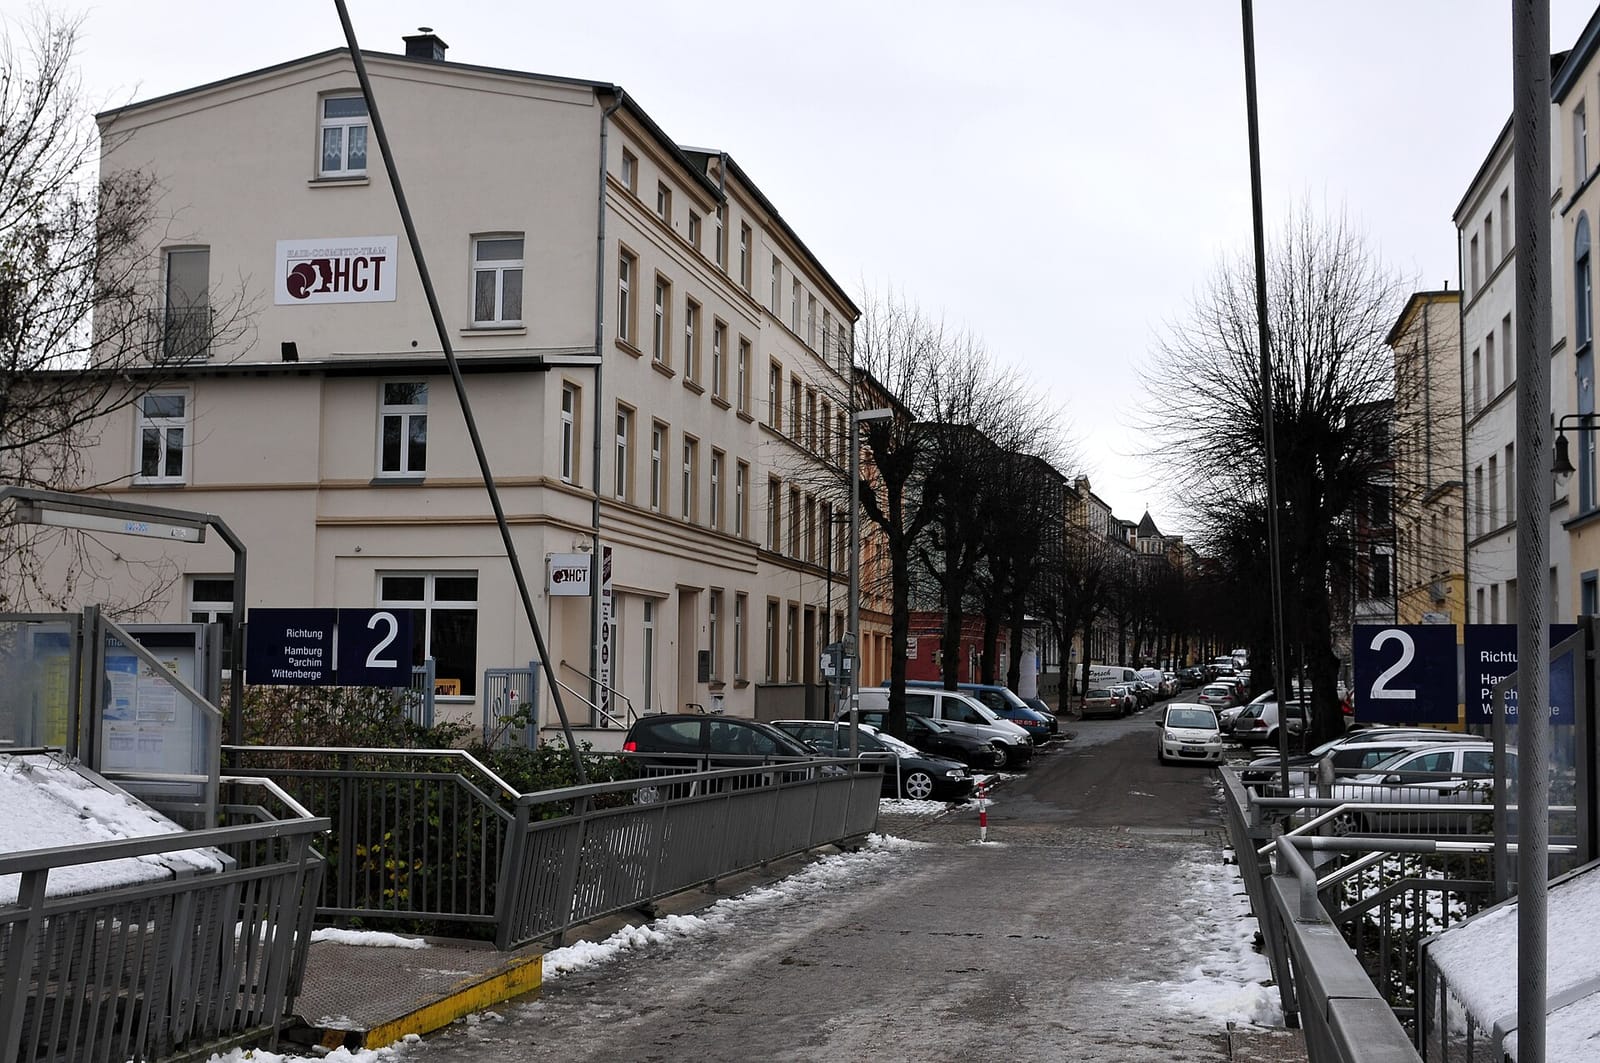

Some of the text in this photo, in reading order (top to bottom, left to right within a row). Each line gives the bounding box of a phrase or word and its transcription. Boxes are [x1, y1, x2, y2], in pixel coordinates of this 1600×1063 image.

[333, 256, 386, 292] HCT
[568, 568, 588, 582] HCT
[286, 628, 323, 640] Richtung
[365, 611, 399, 668] 2
[284, 646, 323, 657] Hamburg
[1480, 650, 1518, 662] Richtu
[1369, 628, 1416, 699] 2
[271, 669, 322, 680] Wittenberge
